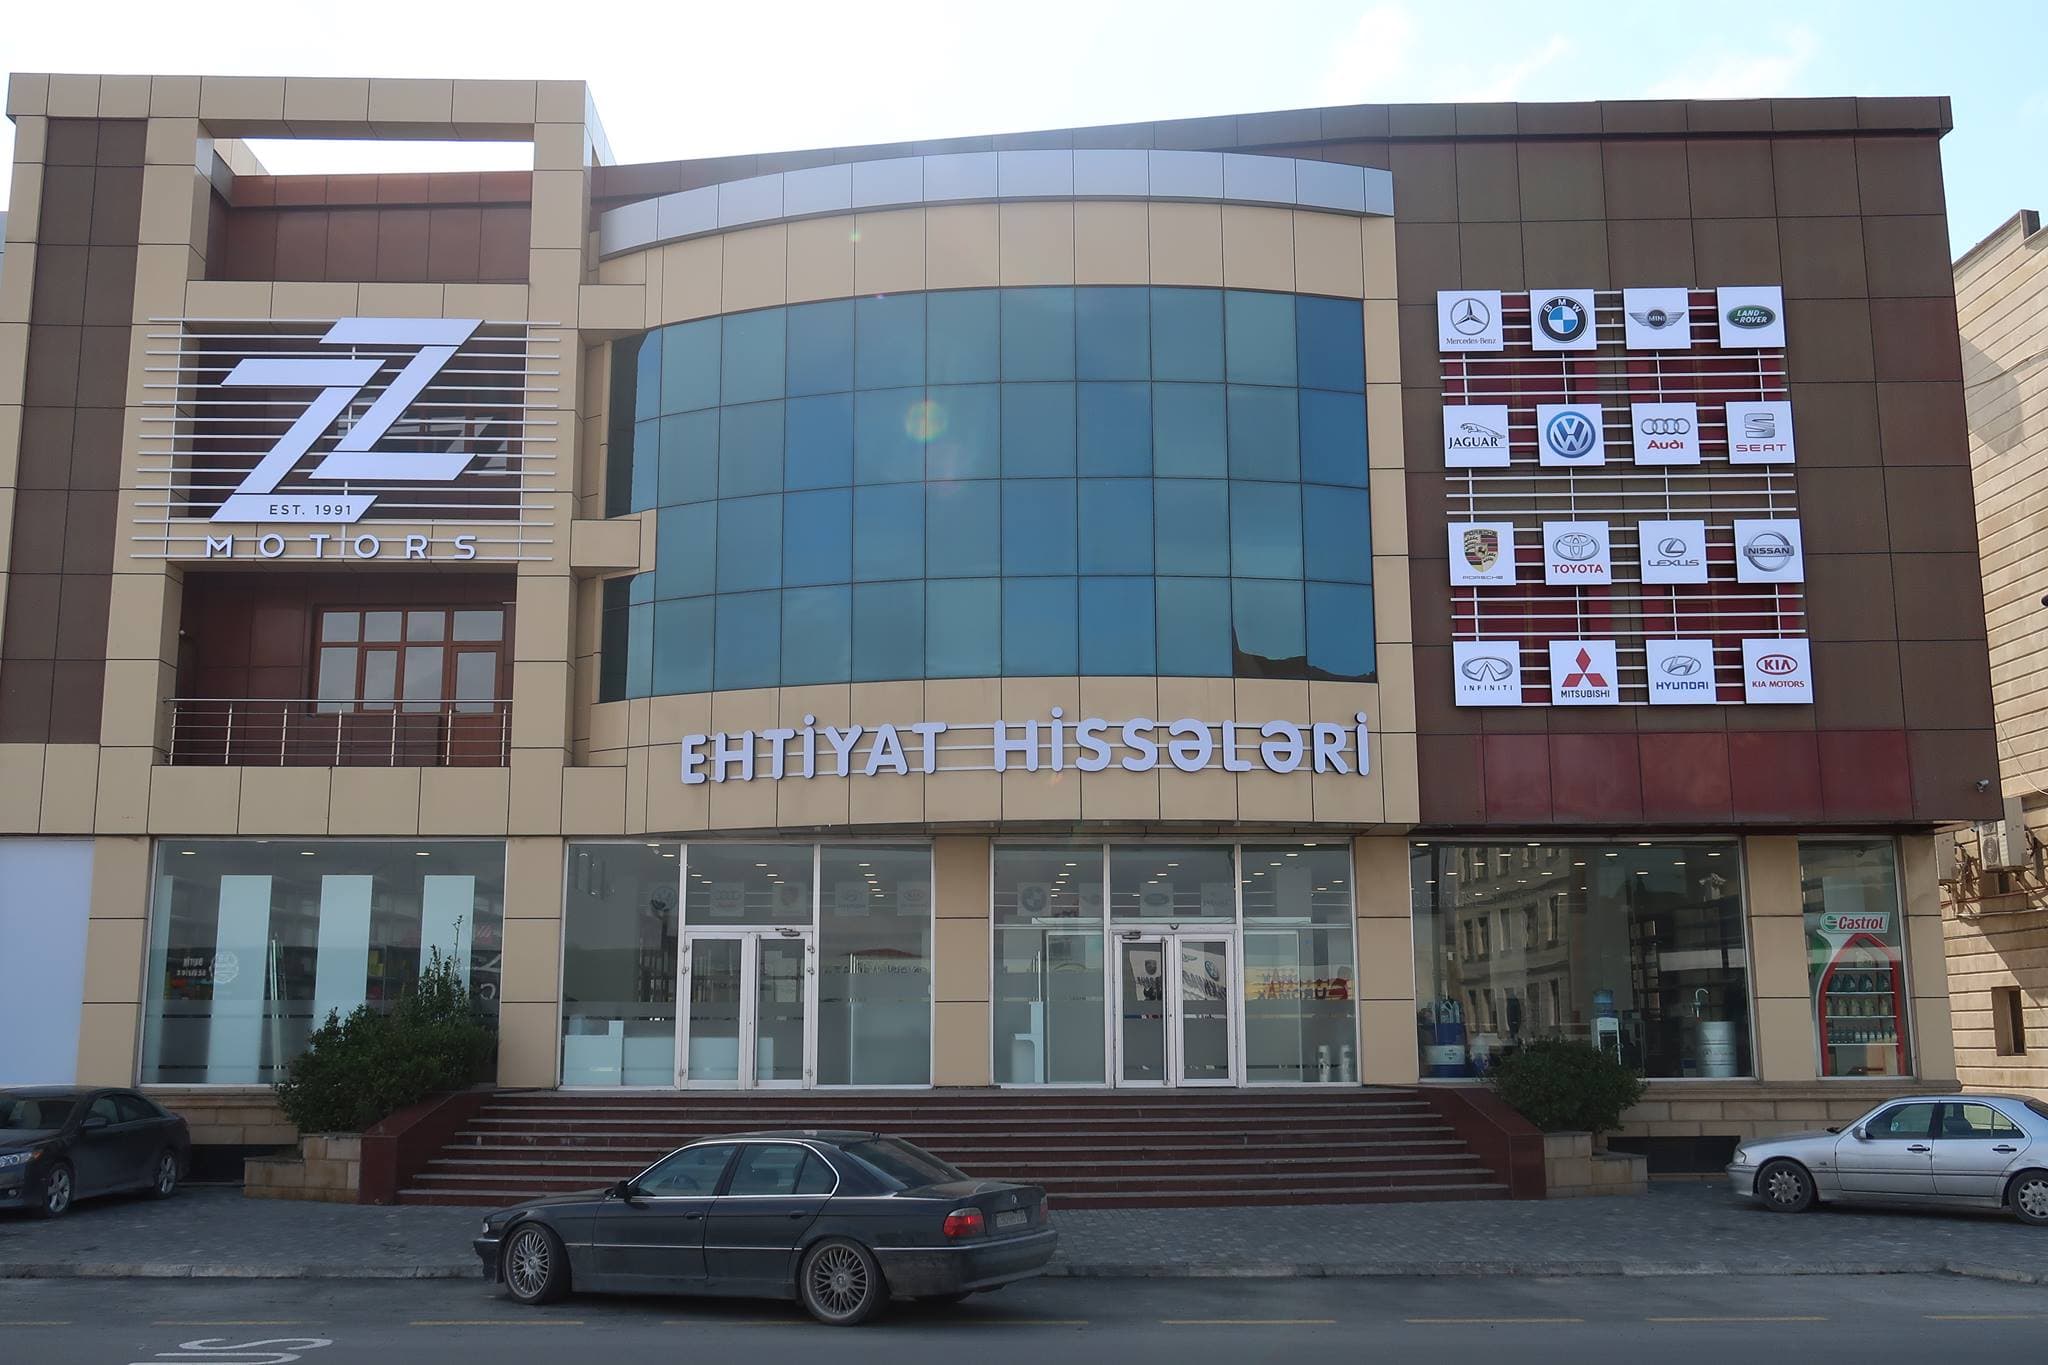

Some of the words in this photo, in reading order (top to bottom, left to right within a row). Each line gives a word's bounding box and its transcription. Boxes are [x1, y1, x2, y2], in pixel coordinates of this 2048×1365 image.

[1544, 298, 1582, 313] BMW
[1648, 314, 1665, 322] MINI
[1446, 337, 1497, 345] Mercedes-Benz
[1448, 436, 1499, 449] JAGUAR
[1647, 439, 1684, 450] Audi
[1735, 444, 1787, 452] SEAT
[269, 504, 305, 516] EST.
[314, 504, 352, 516] 1991
[204, 533, 477, 561] MOTORS
[1748, 547, 1790, 555] NISSAN
[1647, 559, 1700, 567] LEXUS
[1552, 564, 1604, 574] TOYOTA
[1763, 659, 1791, 671] KIA
[1656, 681, 1709, 690] HYUNDAI
[1752, 680, 1767, 688] KIA
[1768, 680, 1805, 688] MOTORS
[1560, 689, 1610, 698] MITSUBISHI
[680, 713, 948, 785] EHTİYAT
[993, 705, 1371, 777] HİSSƏLƏRİ
[1838, 916, 1884, 930] Castrol
